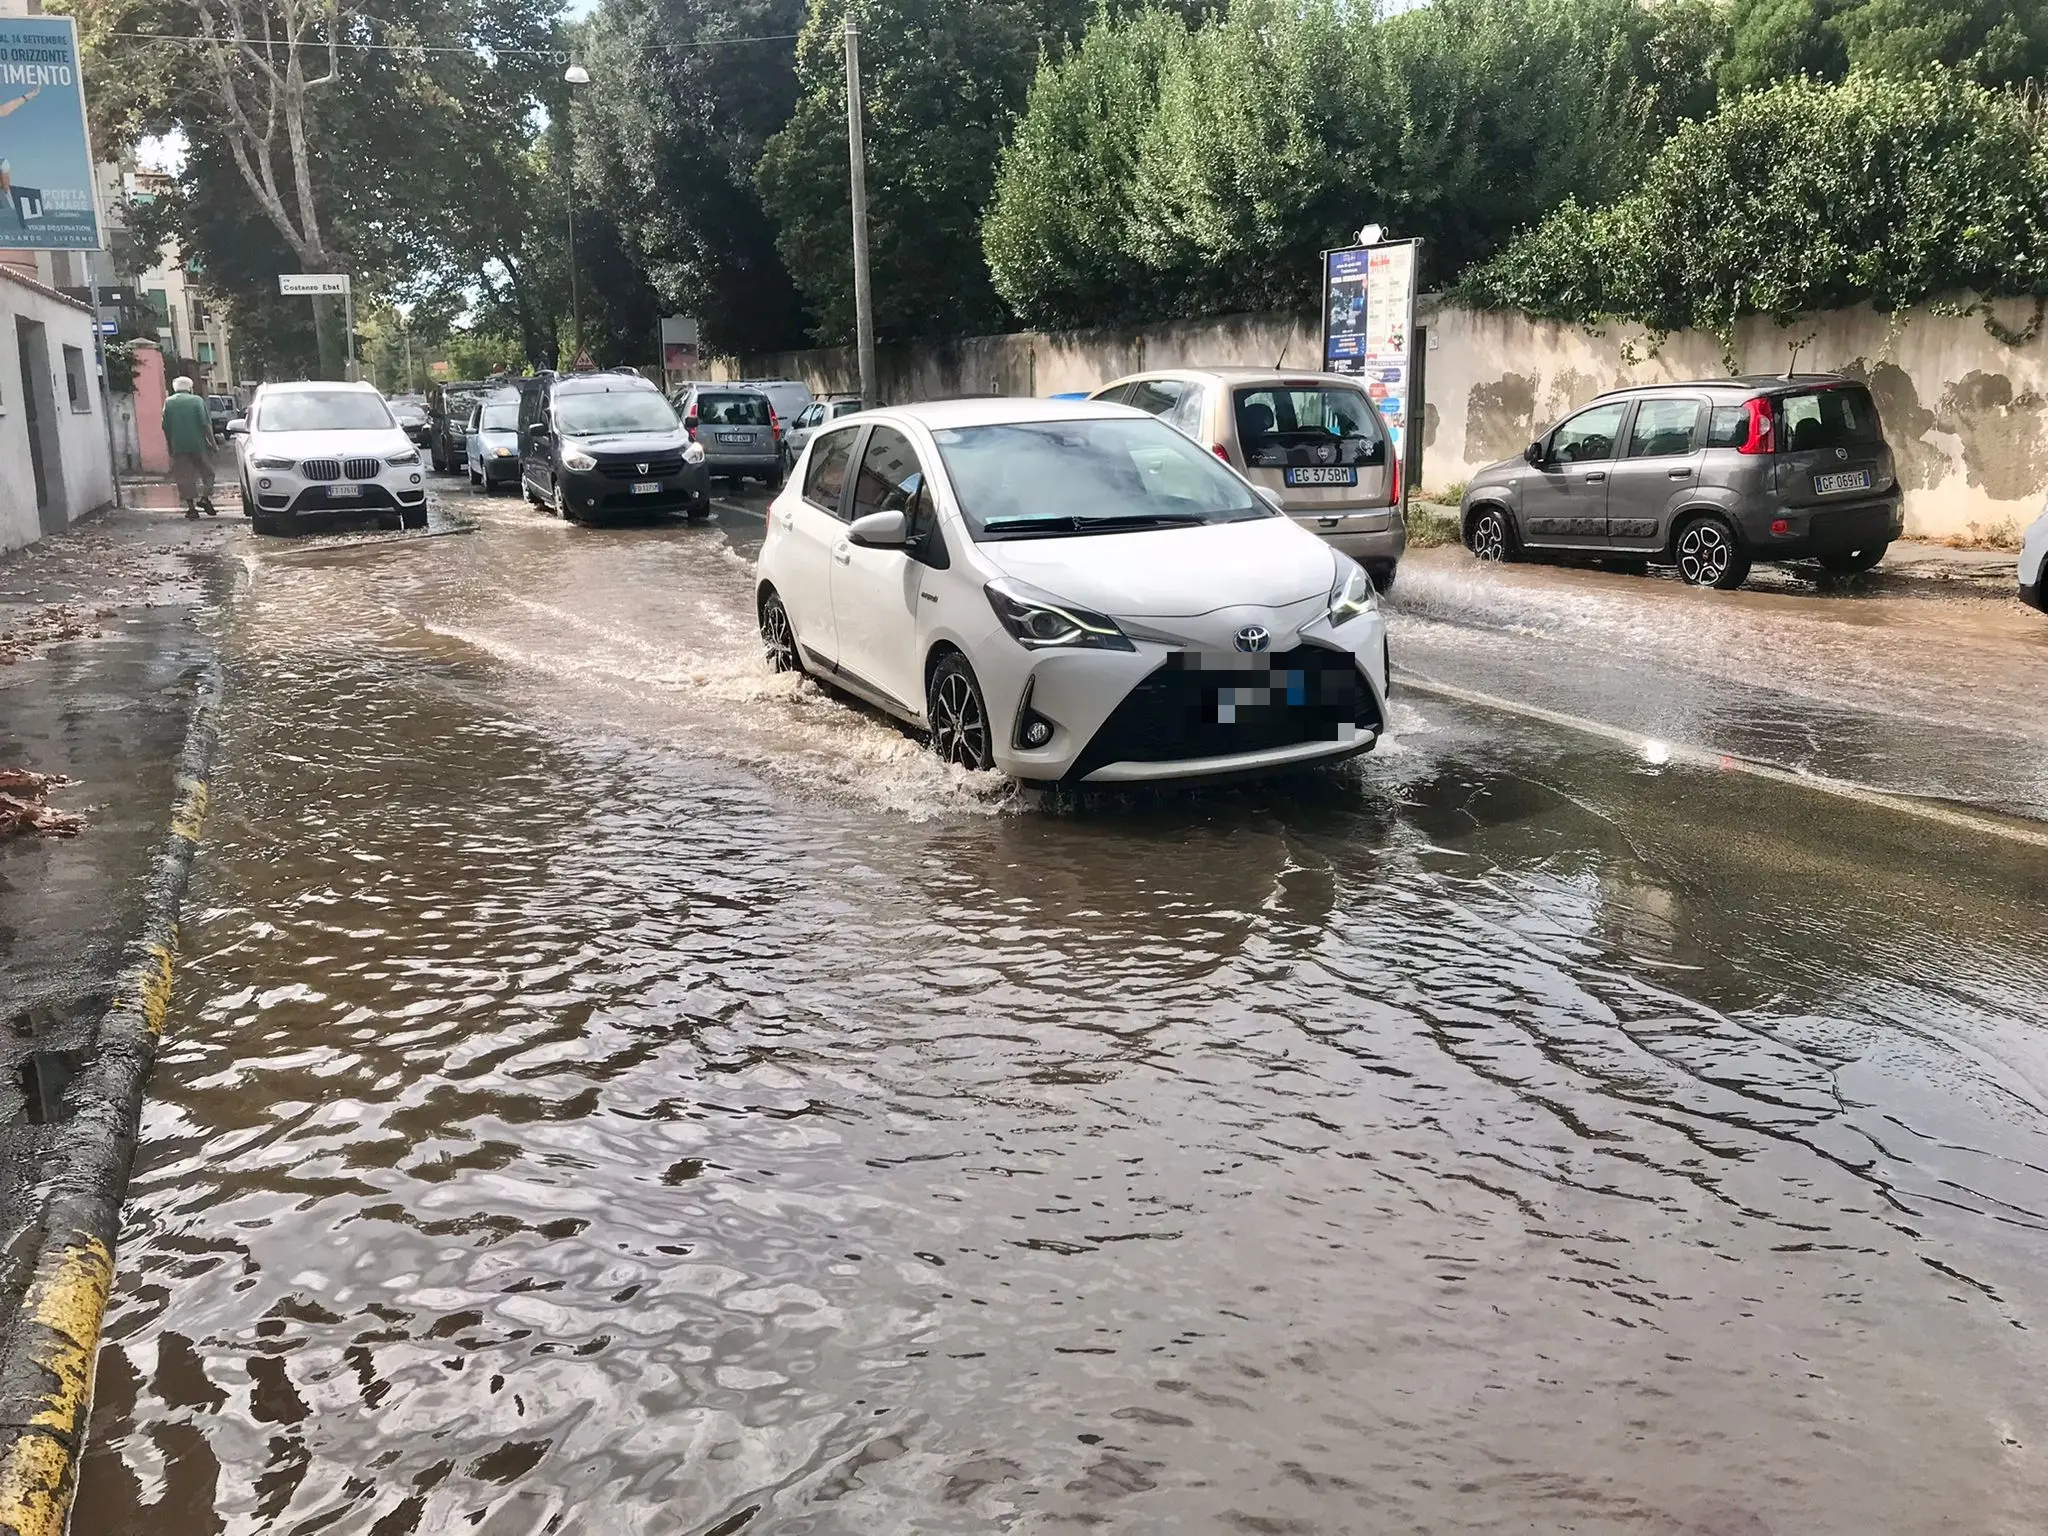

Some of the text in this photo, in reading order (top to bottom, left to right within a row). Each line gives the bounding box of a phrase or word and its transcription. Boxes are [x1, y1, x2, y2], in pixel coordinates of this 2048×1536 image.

[23, 34, 67, 45] SETTEMBRE
[11, 48, 69, 63] ORIZZONTE
[0, 64, 71, 86] IMENTO
[42, 189, 86, 200] PORTA
[55, 202, 88, 210] MARE
[1294, 468, 1348, 482] EG 375BM
[1822, 472, 1863, 490] GF 069VF
